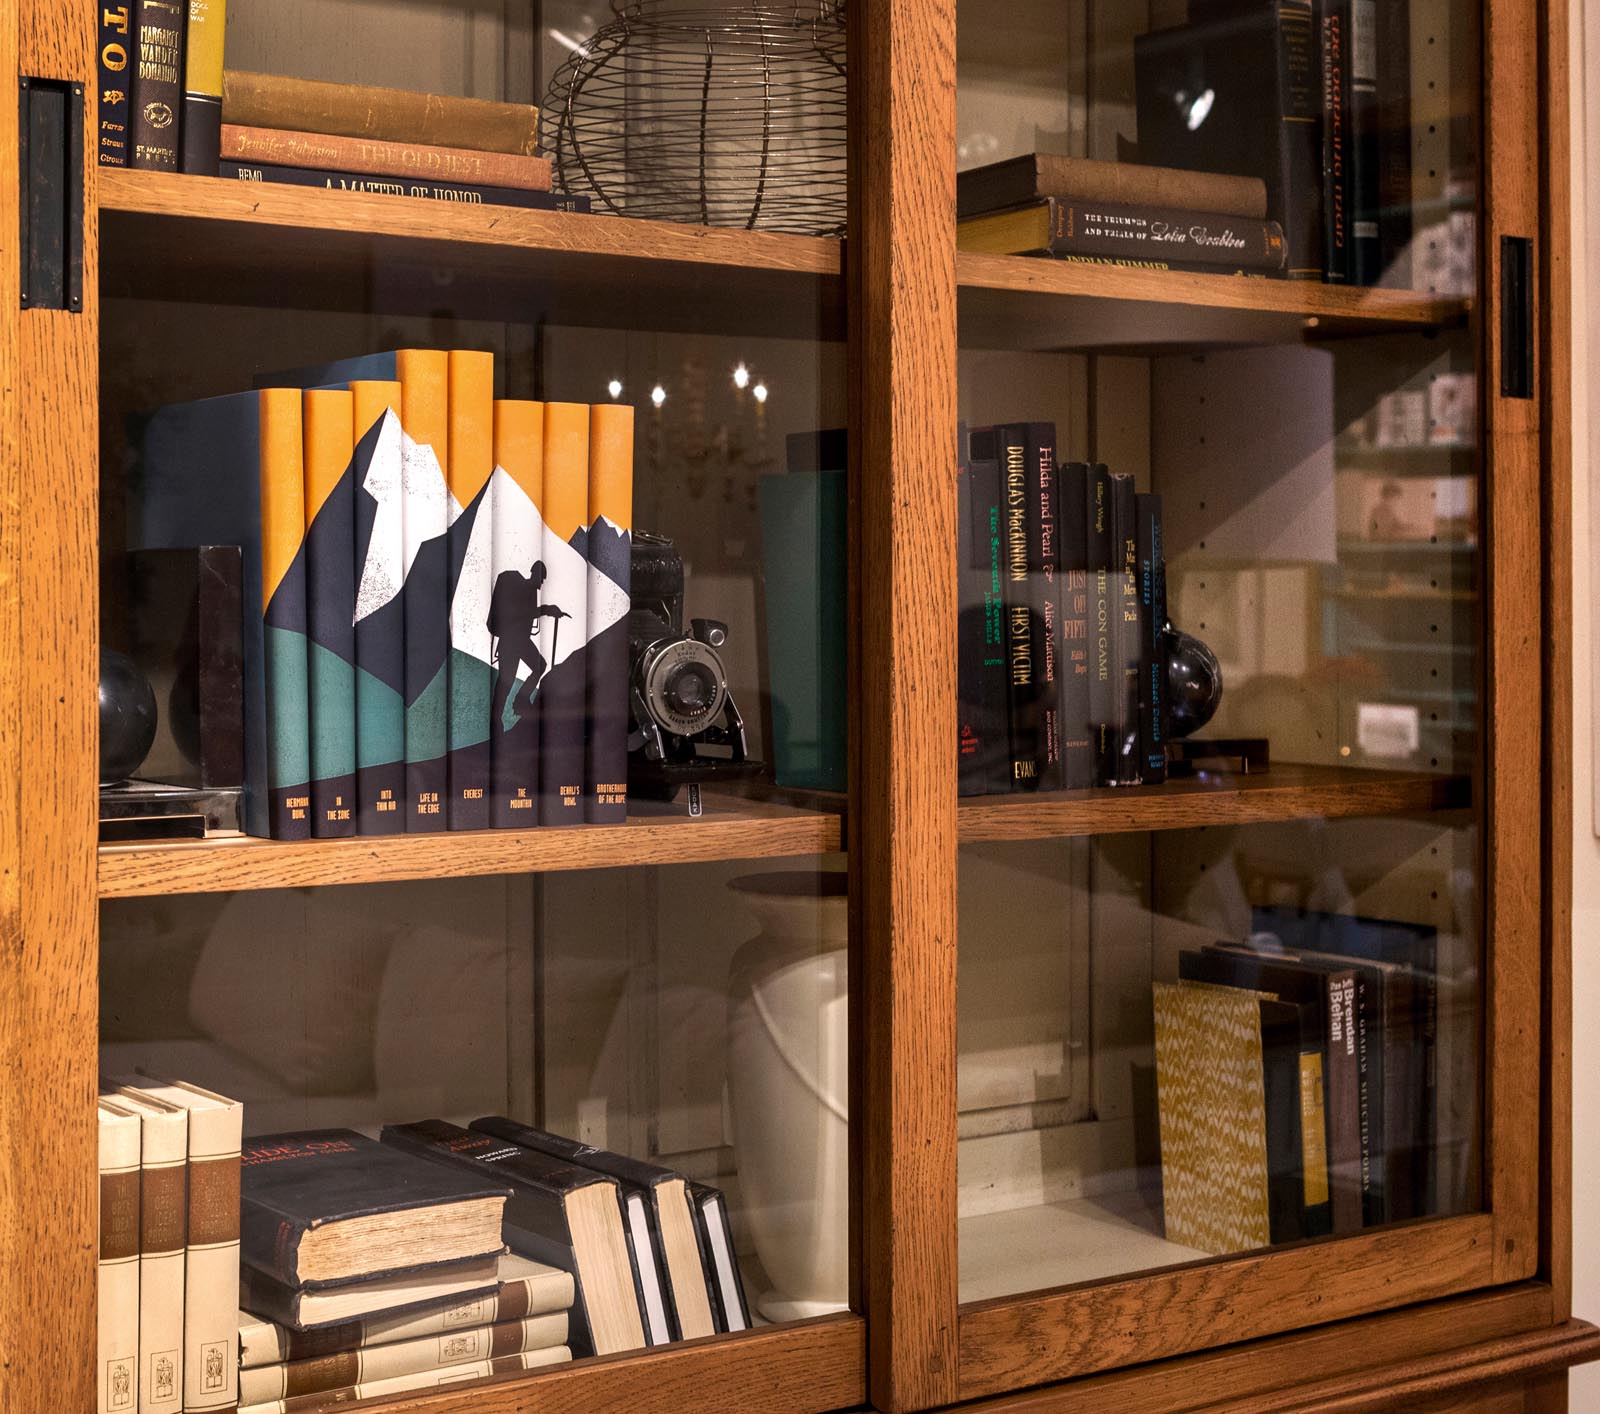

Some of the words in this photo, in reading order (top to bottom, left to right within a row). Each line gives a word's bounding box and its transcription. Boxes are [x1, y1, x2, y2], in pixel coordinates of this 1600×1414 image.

[101, 120, 125, 133] Farrar
[100, 153, 125, 165] Giroux
[237, 134, 287, 154] Jennifer
[288, 139, 338, 162] Johnston
[357, 143, 397, 165] THE
[401, 150, 441, 169] OLD
[443, 154, 484, 176] JEST
[1084, 227, 1102, 238] AND
[1136, 230, 1147, 240] OF
[1006, 445, 1025, 506] DOUGLAS
[1039, 446, 1053, 489] Hilda
[1040, 492, 1054, 519] and
[1041, 523, 1055, 558] Pearl
[1097, 566, 1107, 595] THE
[992, 597, 1003, 645] Power
[1011, 606, 1030, 642] FIRST
[1044, 600, 1056, 631] Alice
[1097, 599, 1108, 632] CON
[1013, 644, 1032, 686] VICTIM
[1044, 632, 1057, 682] Mattison
[1098, 636, 1109, 681] GAME
[380, 789, 392, 800] INTO
[420, 792, 431, 804] LIFE
[463, 788, 483, 800] EVEREST
[517, 787, 527, 798] THE
[598, 795, 605, 804] OF
[606, 794, 615, 804] THE
[327, 810, 337, 821] THE
[418, 803, 427, 815] THE
[427, 803, 440, 814] EDGE
[1330, 991, 1344, 1042] Behan
[1344, 988, 1356, 1056] Brendan
[1359, 1018, 1368, 1074] GRAHAM
